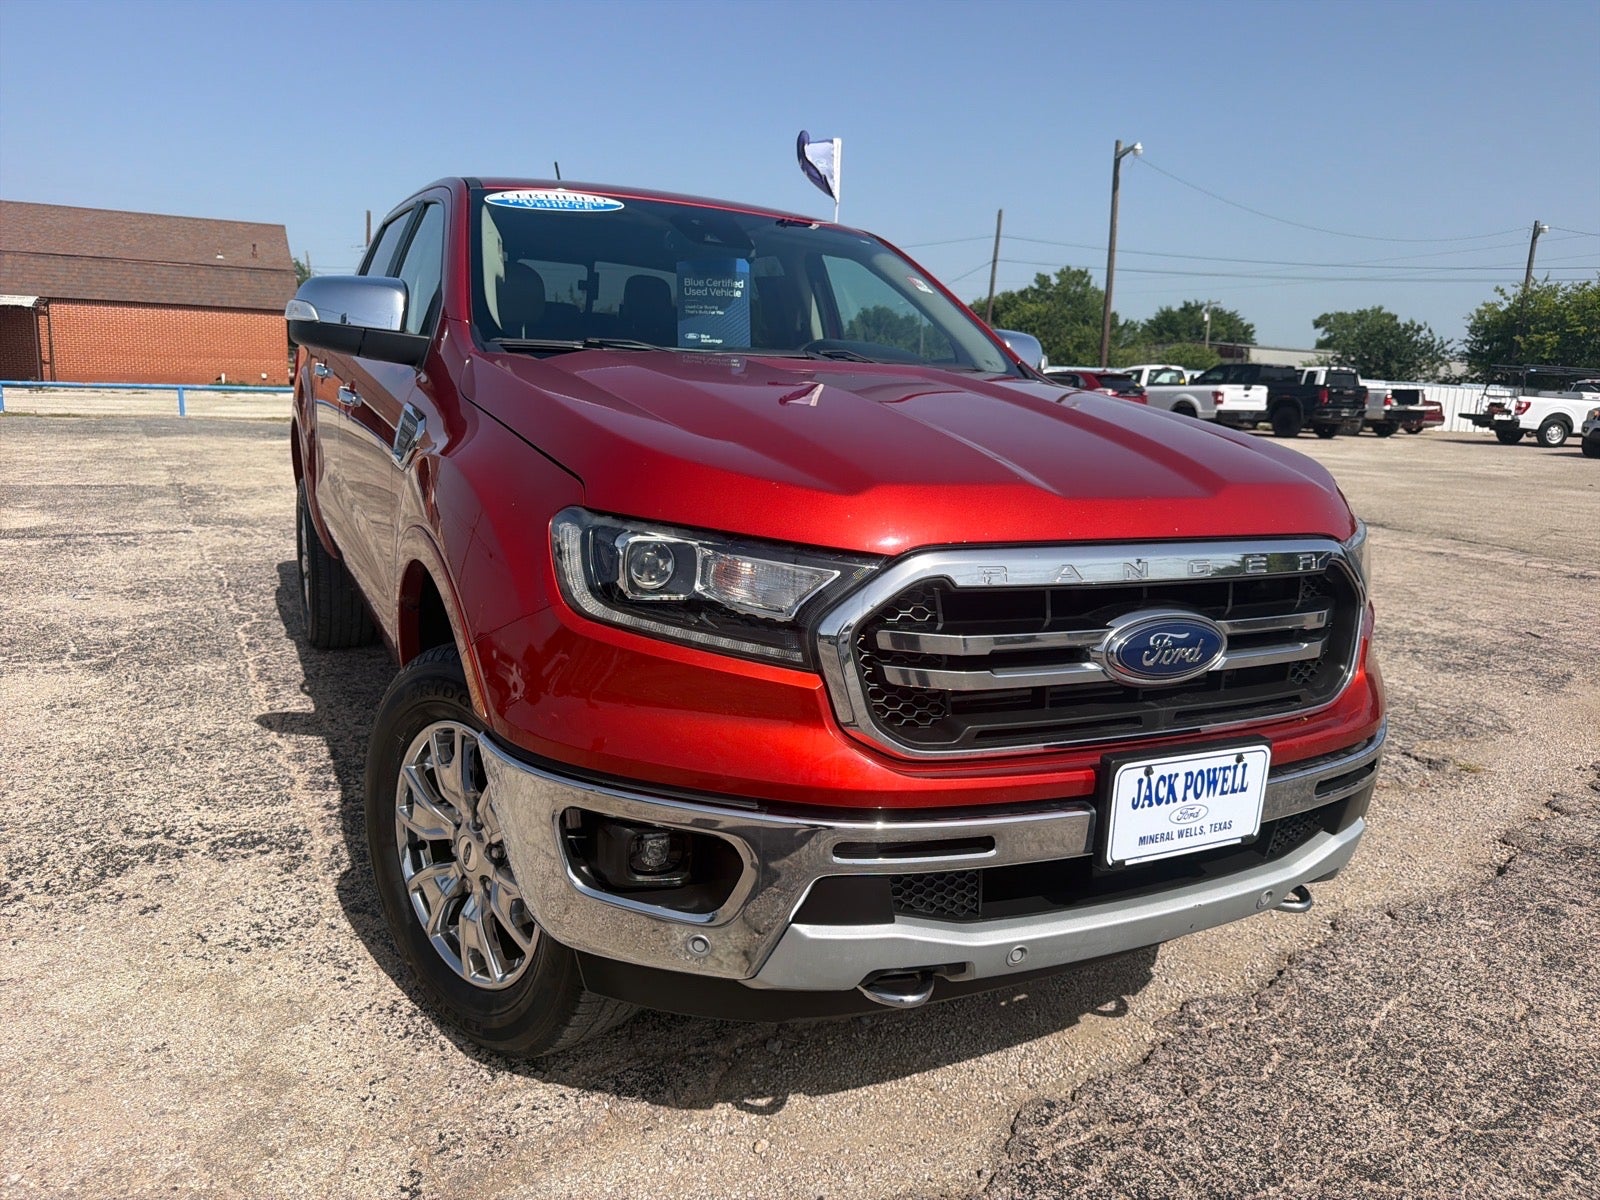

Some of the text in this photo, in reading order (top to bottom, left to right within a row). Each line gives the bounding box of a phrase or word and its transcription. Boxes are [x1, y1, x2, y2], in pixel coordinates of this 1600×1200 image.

[684, 278, 744, 288] Blue Certified
[684, 288, 742, 297] Used Vehicle
[977, 553, 1318, 584] RANGER
[1141, 632, 1204, 666] Ford
[1132, 763, 1248, 810] JACK POWELL
[1176, 807, 1202, 822] Ford
[1138, 820, 1233, 846] MINERAL WELLS, TEXAS
